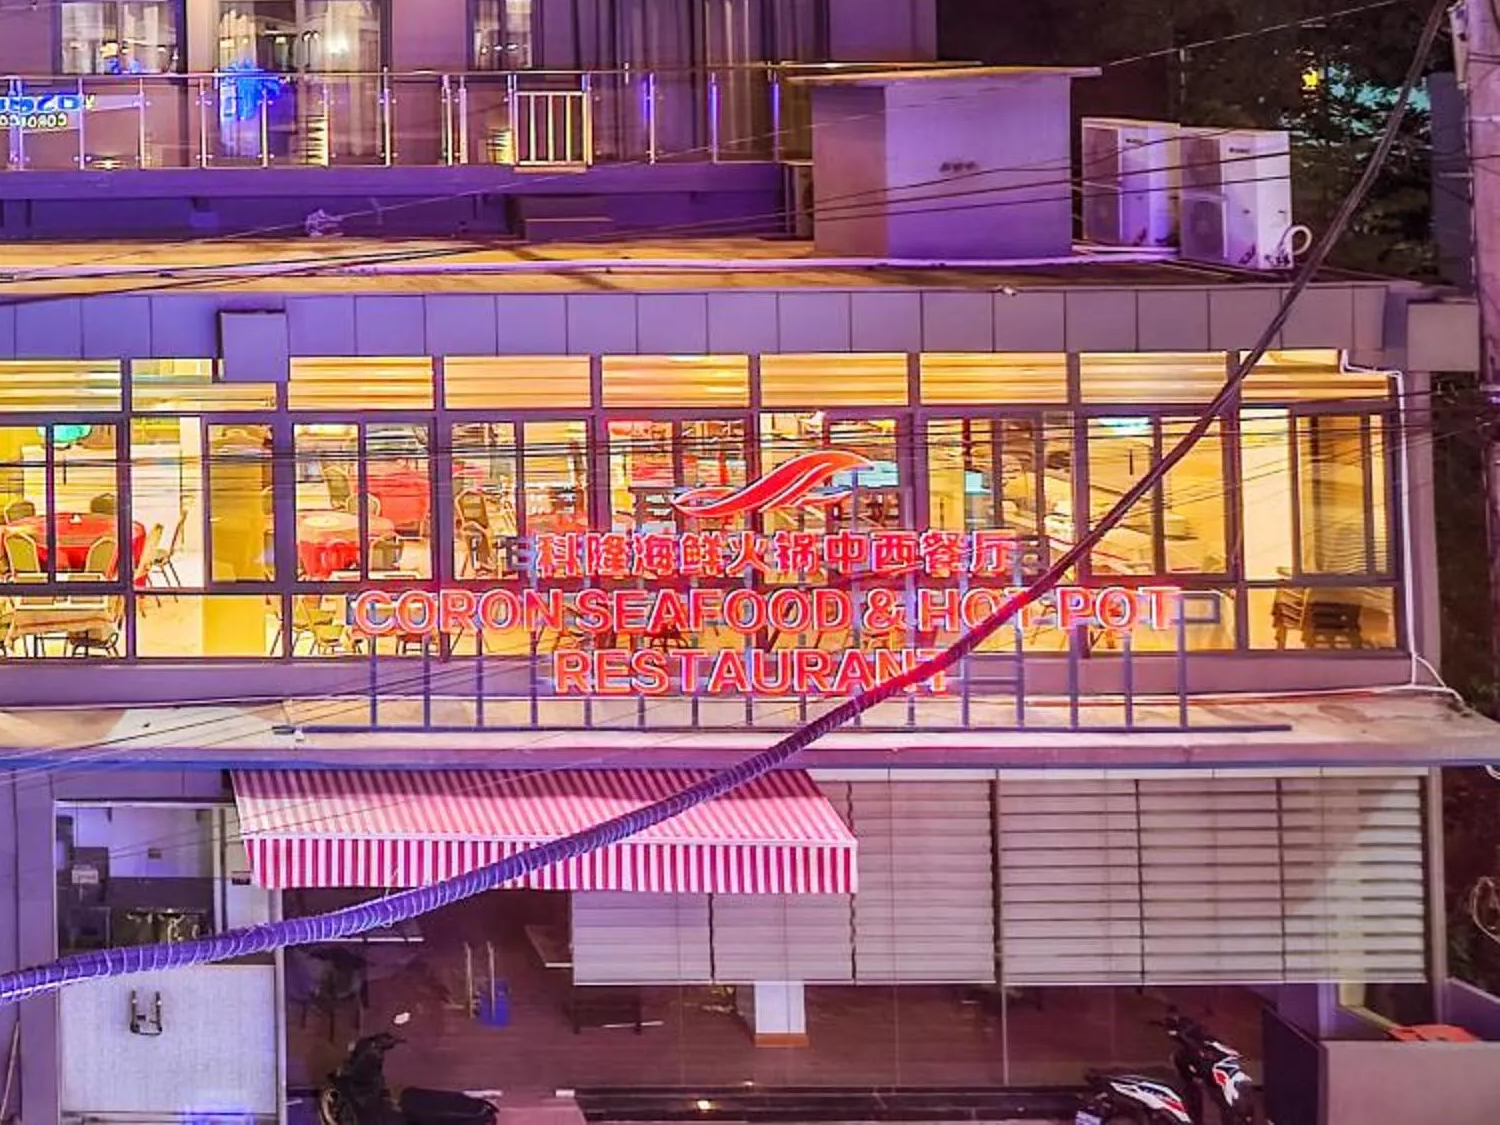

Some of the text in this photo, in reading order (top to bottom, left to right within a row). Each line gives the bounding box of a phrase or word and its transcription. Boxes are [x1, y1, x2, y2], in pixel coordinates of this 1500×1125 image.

[535, 531, 1016, 576] 科隆海鲜火锅中西餐厅
[354, 588, 564, 634] CORON
[574, 587, 853, 634] SEAFOOD
[863, 587, 907, 632] &
[1056, 586, 1181, 632] POT
